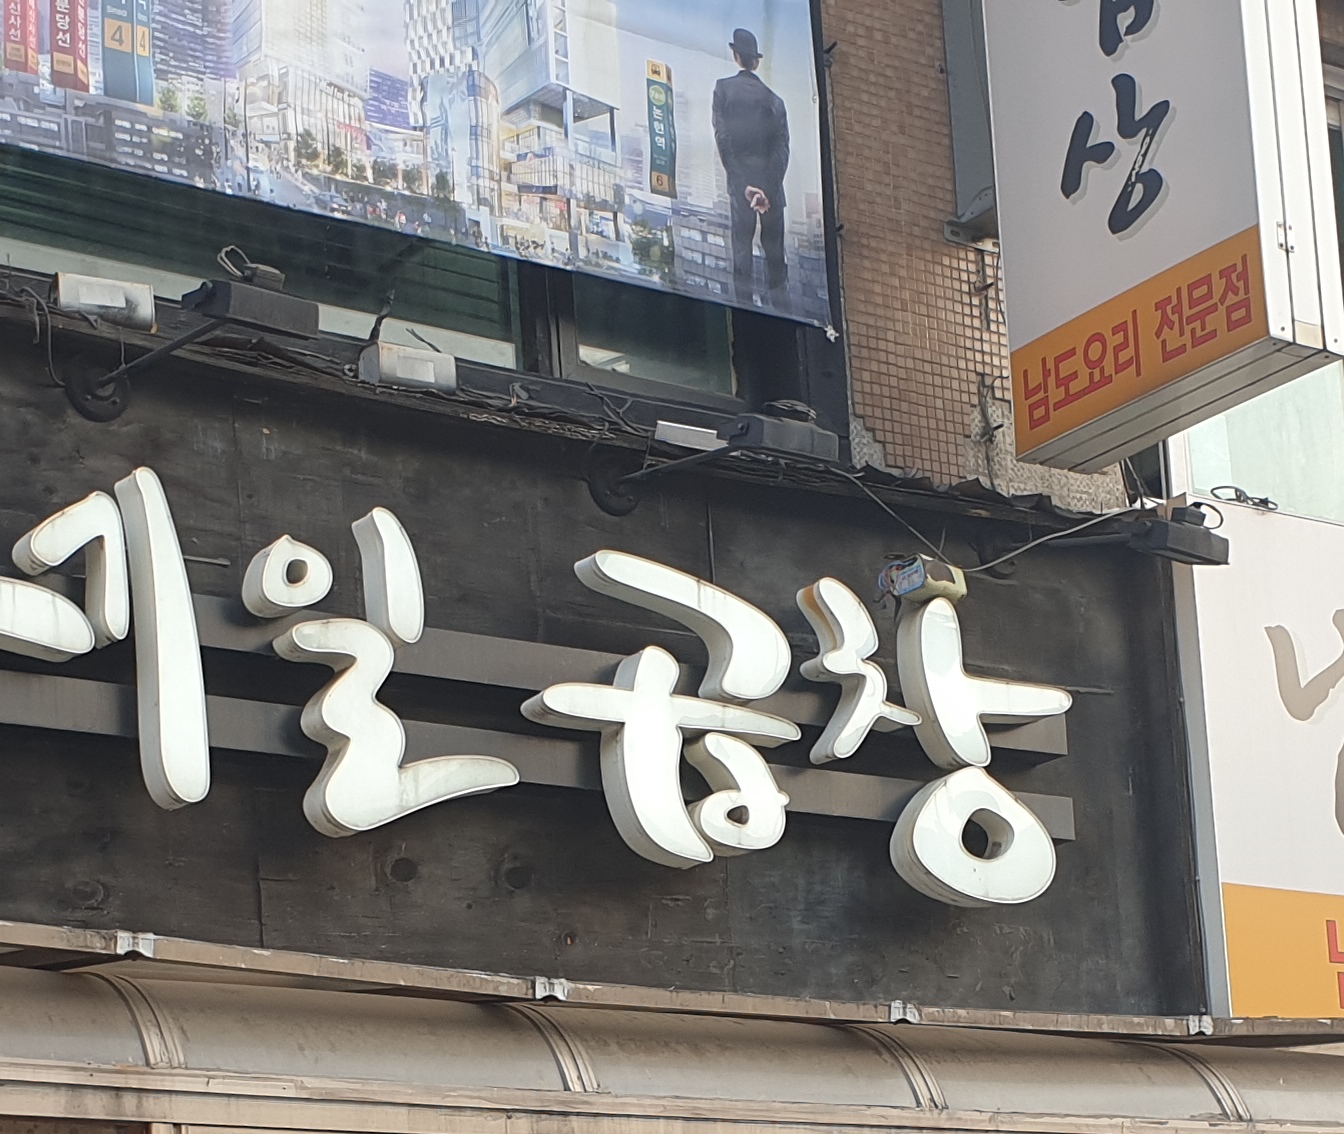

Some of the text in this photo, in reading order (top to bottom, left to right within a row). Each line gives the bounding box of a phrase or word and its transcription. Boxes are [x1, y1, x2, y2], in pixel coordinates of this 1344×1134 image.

[111, 25, 126, 46] 4
[1021, 254, 1254, 432] 남도요리 전문점
